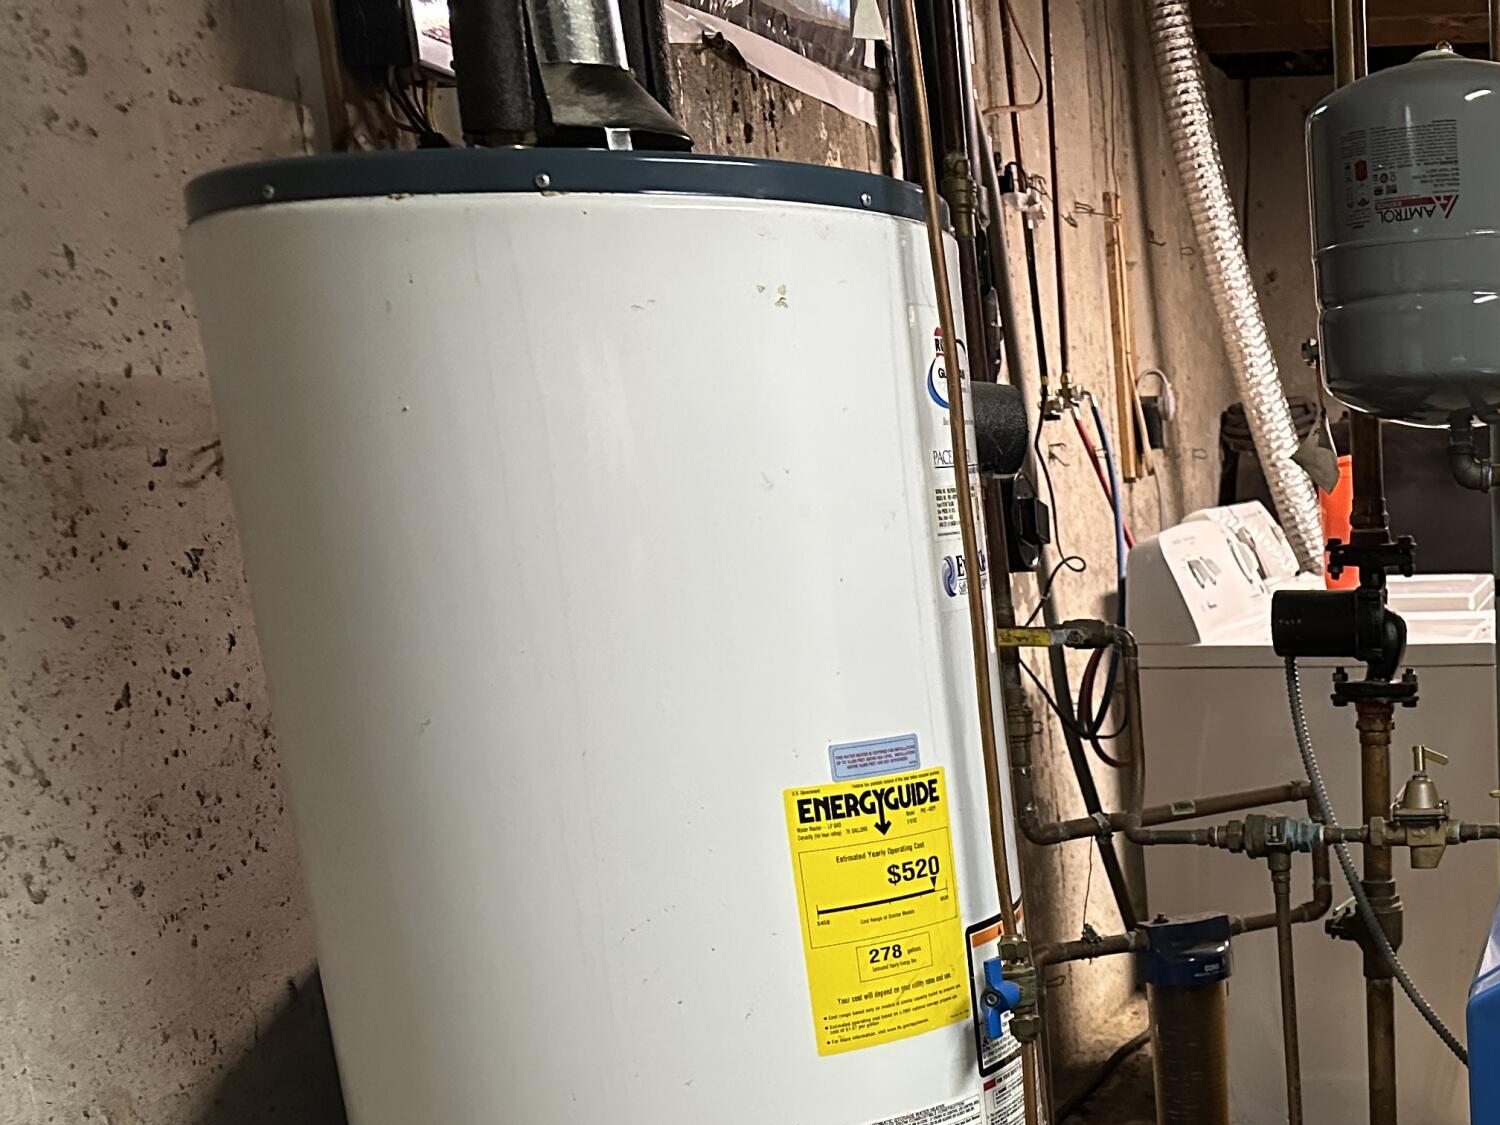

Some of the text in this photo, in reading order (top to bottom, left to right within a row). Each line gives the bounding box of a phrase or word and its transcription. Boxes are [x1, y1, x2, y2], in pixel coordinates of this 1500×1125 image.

[1376, 205, 1436, 223] AMTROL
[797, 778, 940, 824] ENERGYGUIDE
[868, 849, 885, 859] Yearly
[887, 844, 912, 855] Operating
[914, 841, 924, 849] Cost
[887, 855, 940, 886] $520
[869, 944, 902, 964] 278
